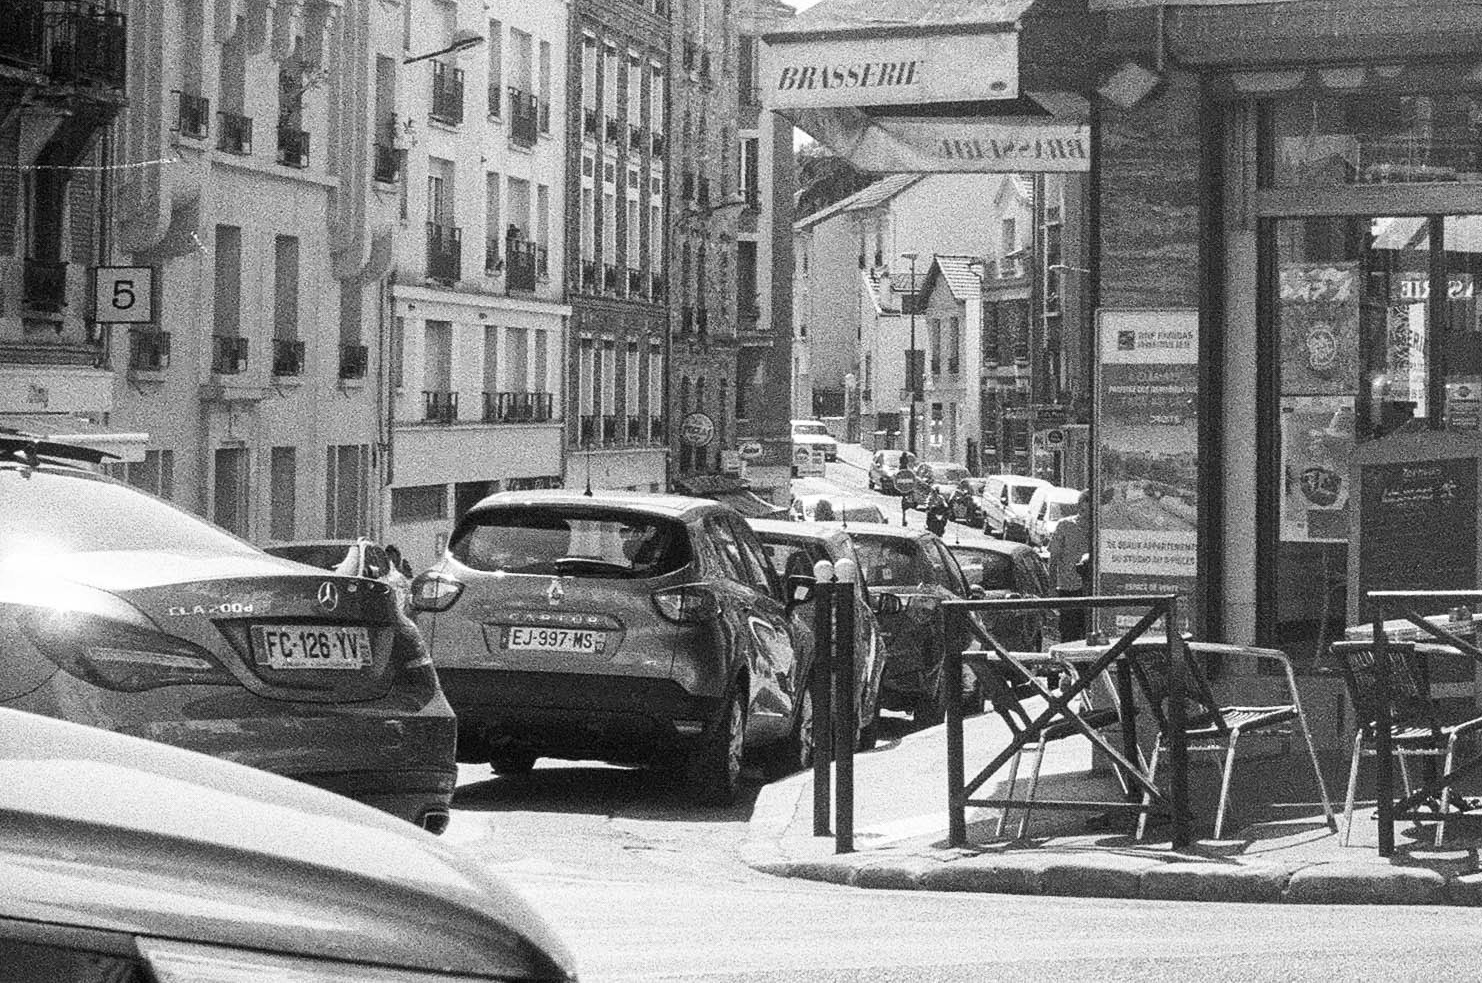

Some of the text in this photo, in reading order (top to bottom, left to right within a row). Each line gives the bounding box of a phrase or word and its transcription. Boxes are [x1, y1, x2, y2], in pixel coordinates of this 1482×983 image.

[776, 59, 924, 92] BRASSERIE
[111, 279, 136, 310] 5
[168, 605, 206, 617] CLA
[265, 631, 360, 660] FC-126-YV
[512, 629, 594, 650] EJ-997-MS
